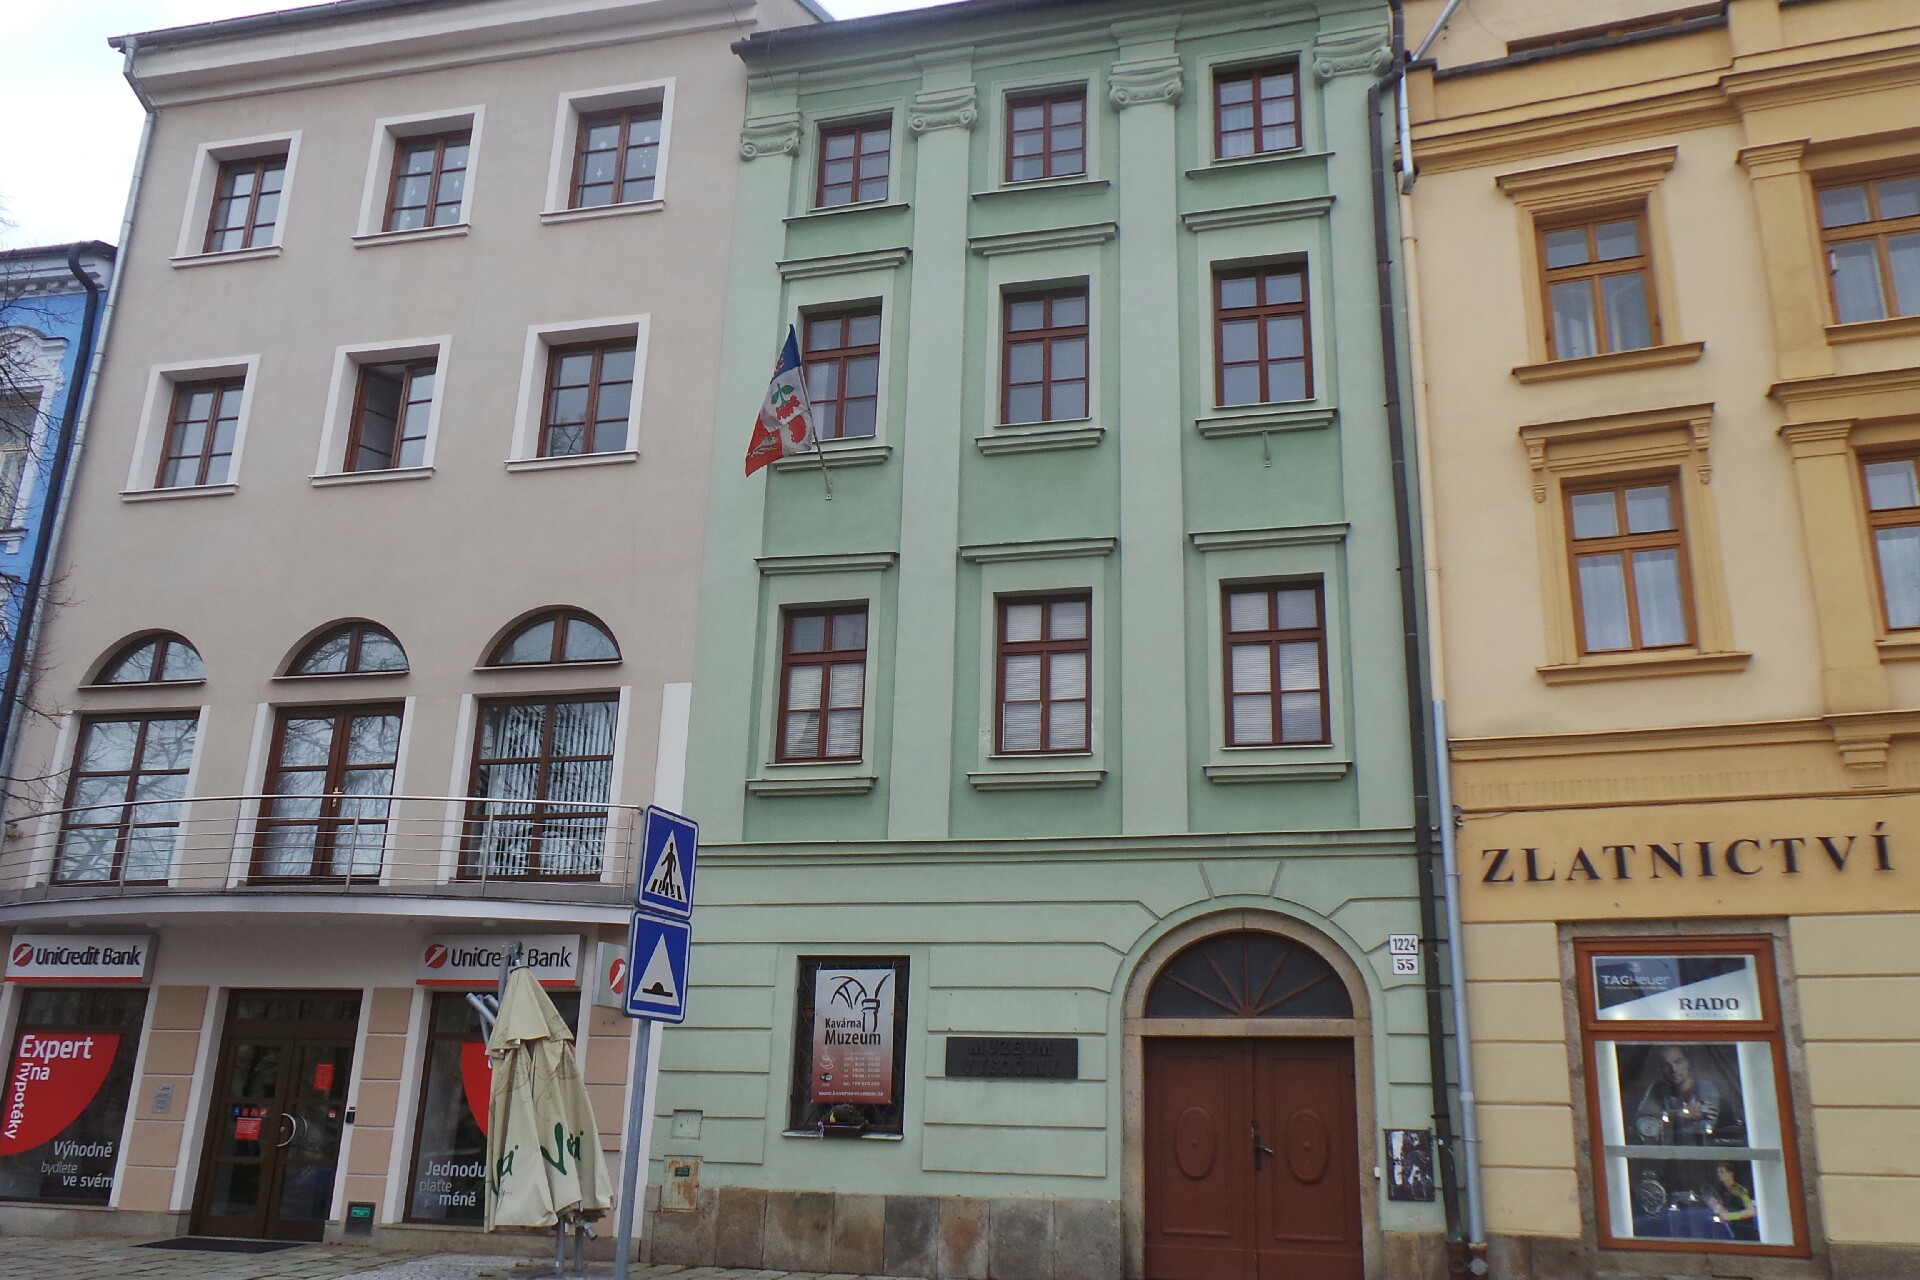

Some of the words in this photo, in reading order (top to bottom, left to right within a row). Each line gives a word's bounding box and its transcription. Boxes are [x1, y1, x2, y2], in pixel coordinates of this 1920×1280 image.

[1481, 821, 1896, 884] ZLATNICTVÍ
[1392, 937, 1416, 951] 1224
[35, 946, 101, 966] UniCredit
[101, 945, 143, 966] Bank
[527, 946, 572, 968] Bank
[1396, 958, 1415, 971] 55
[1678, 997, 1740, 1011] RADO
[824, 1016, 862, 1029] Kavárna
[824, 1029, 881, 1046] Muzeum
[19, 1034, 94, 1064] Expert
[30, 1066, 51, 1081] na
[54, 1140, 114, 1160] Výhodně
[41, 1161, 79, 1176] bydlete
[62, 1174, 77, 1187] ve
[79, 1173, 114, 1188] svém
[419, 1179, 453, 1193] plaťte
[438, 1190, 477, 1207] méně
